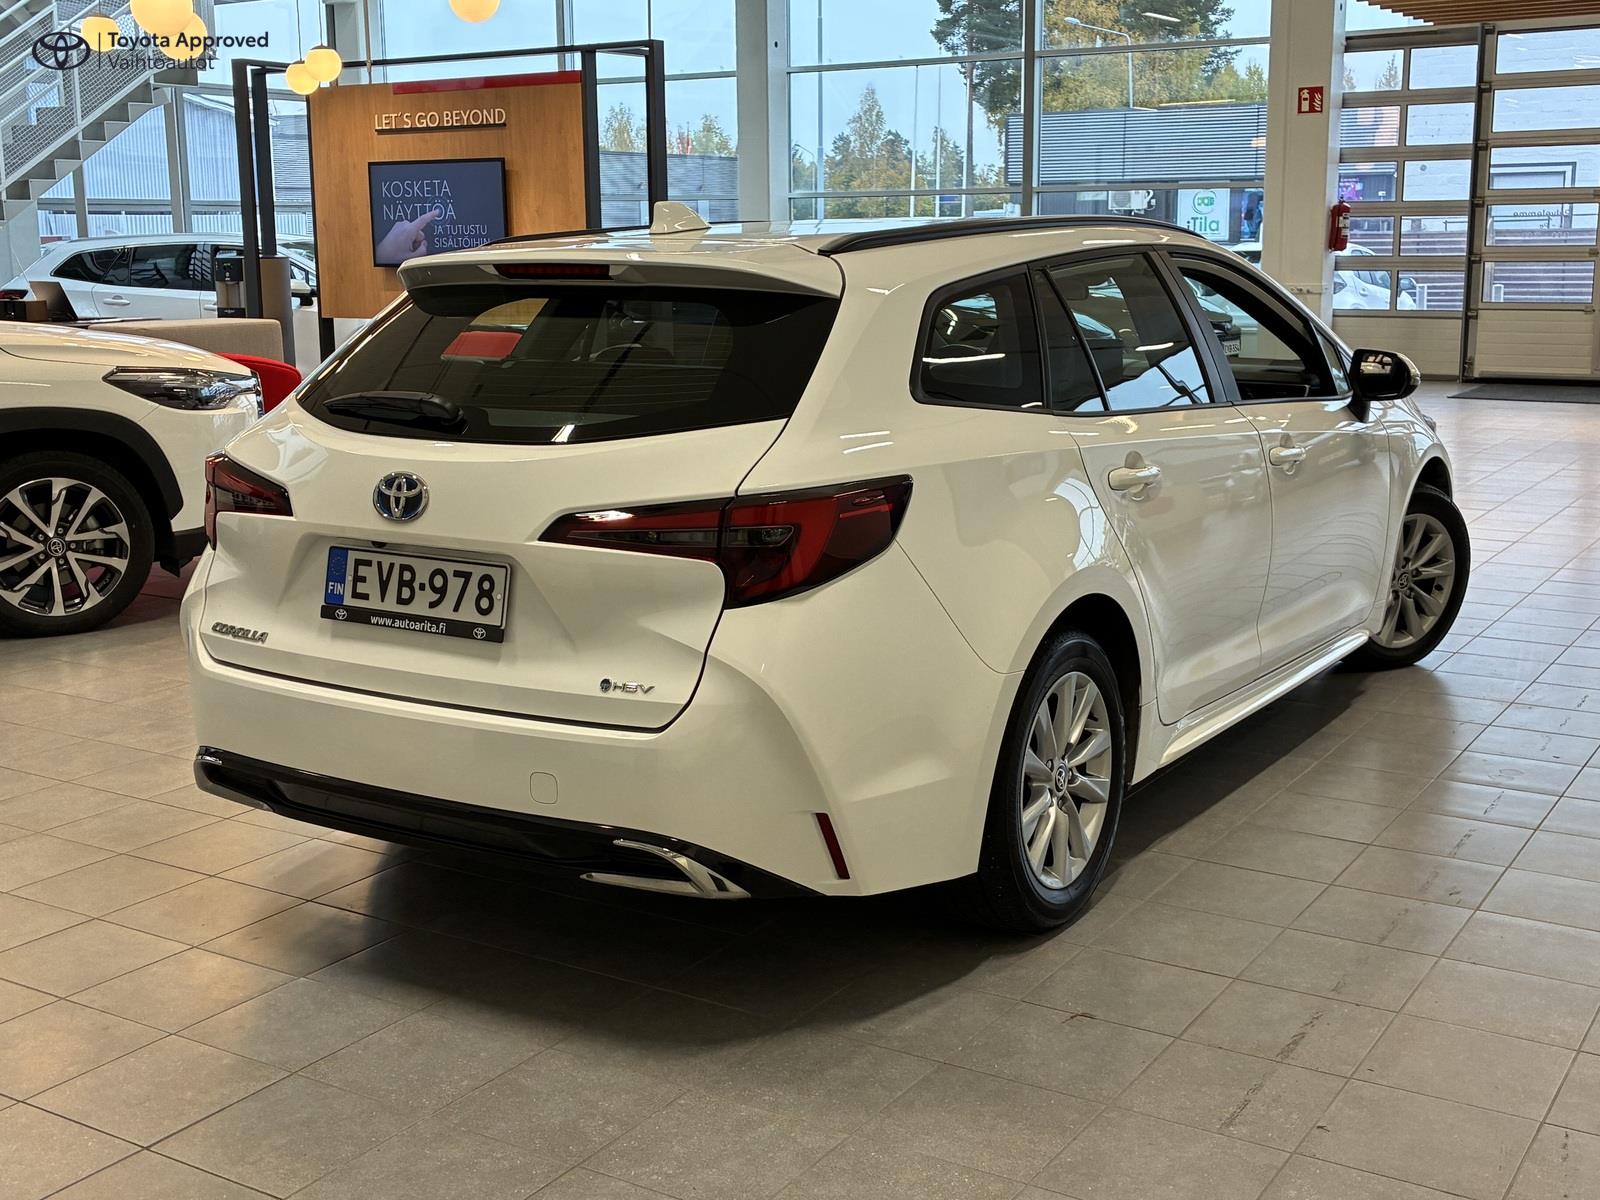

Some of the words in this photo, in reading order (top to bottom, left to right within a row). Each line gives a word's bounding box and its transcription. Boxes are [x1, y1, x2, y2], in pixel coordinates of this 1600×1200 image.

[415, 111, 440, 127] GO
[443, 108, 506, 126] BEYOND
[381, 180, 452, 198] KOSKETA
[383, 200, 457, 221] NÄYTTÖÄ
[433, 224, 444, 236] JA
[446, 224, 488, 235] TUTUSTU
[1186, 216, 1220, 232] iTila
[328, 581, 345, 596] FIN
[351, 558, 496, 616] EVB-978
[370, 615, 447, 634] www.autoarita.fi
